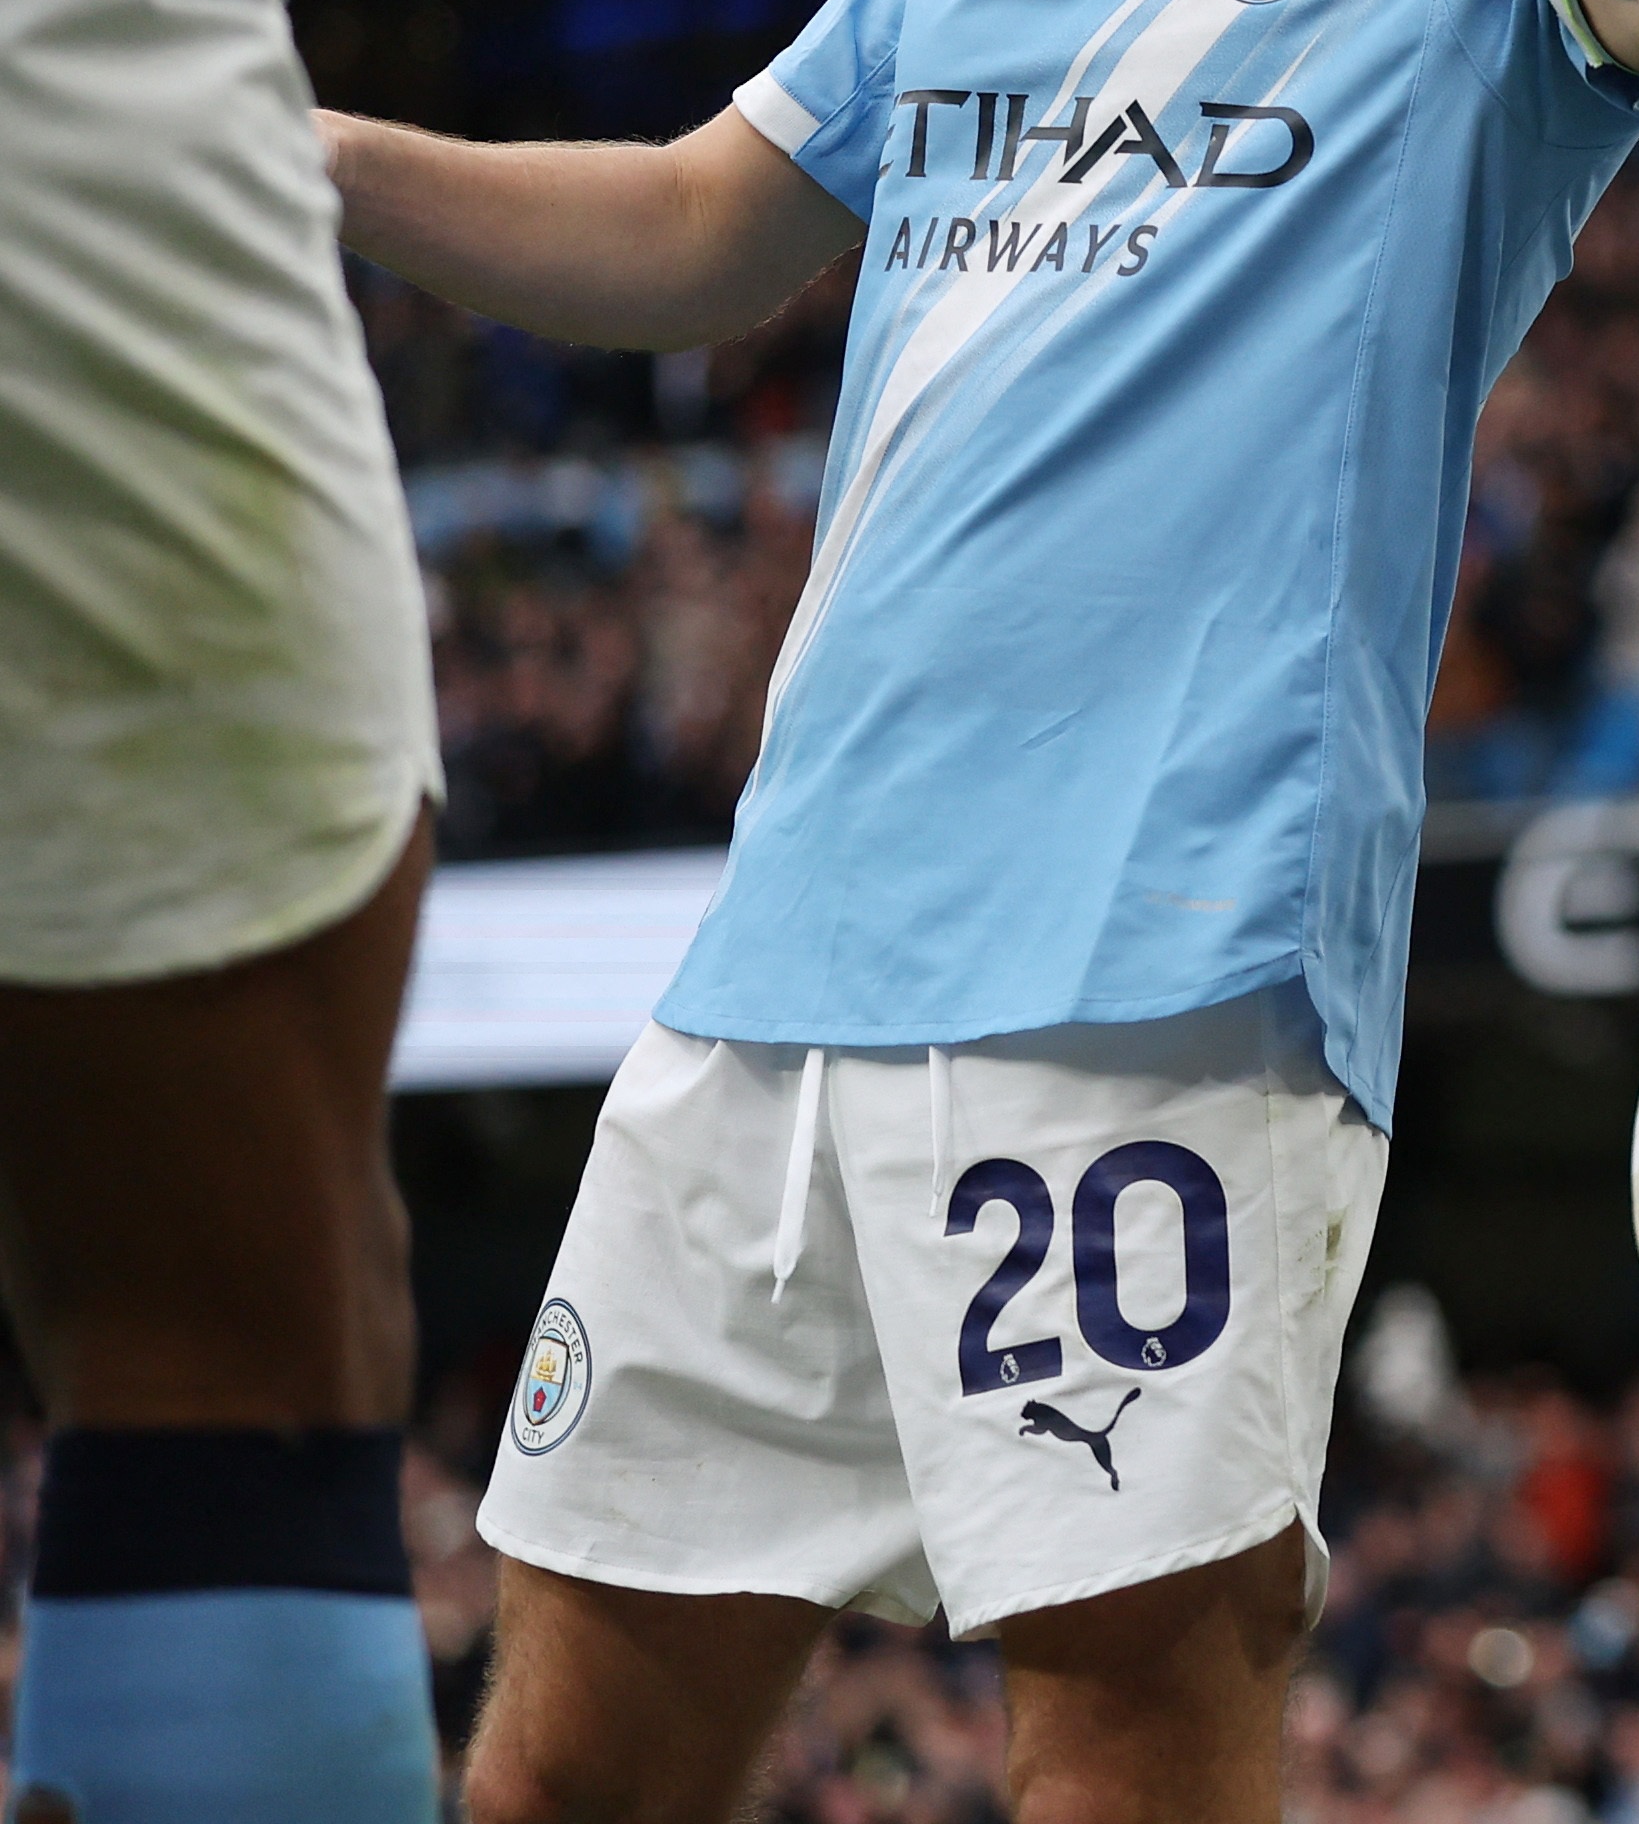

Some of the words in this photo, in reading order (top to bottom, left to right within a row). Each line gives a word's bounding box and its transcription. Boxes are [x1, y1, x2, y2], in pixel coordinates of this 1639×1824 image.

[879, 89, 1315, 189] TIHAD
[884, 216, 1159, 277] AIRWAYS
[943, 1139, 1231, 1397] 20
[522, 1427, 545, 1445] CITY
